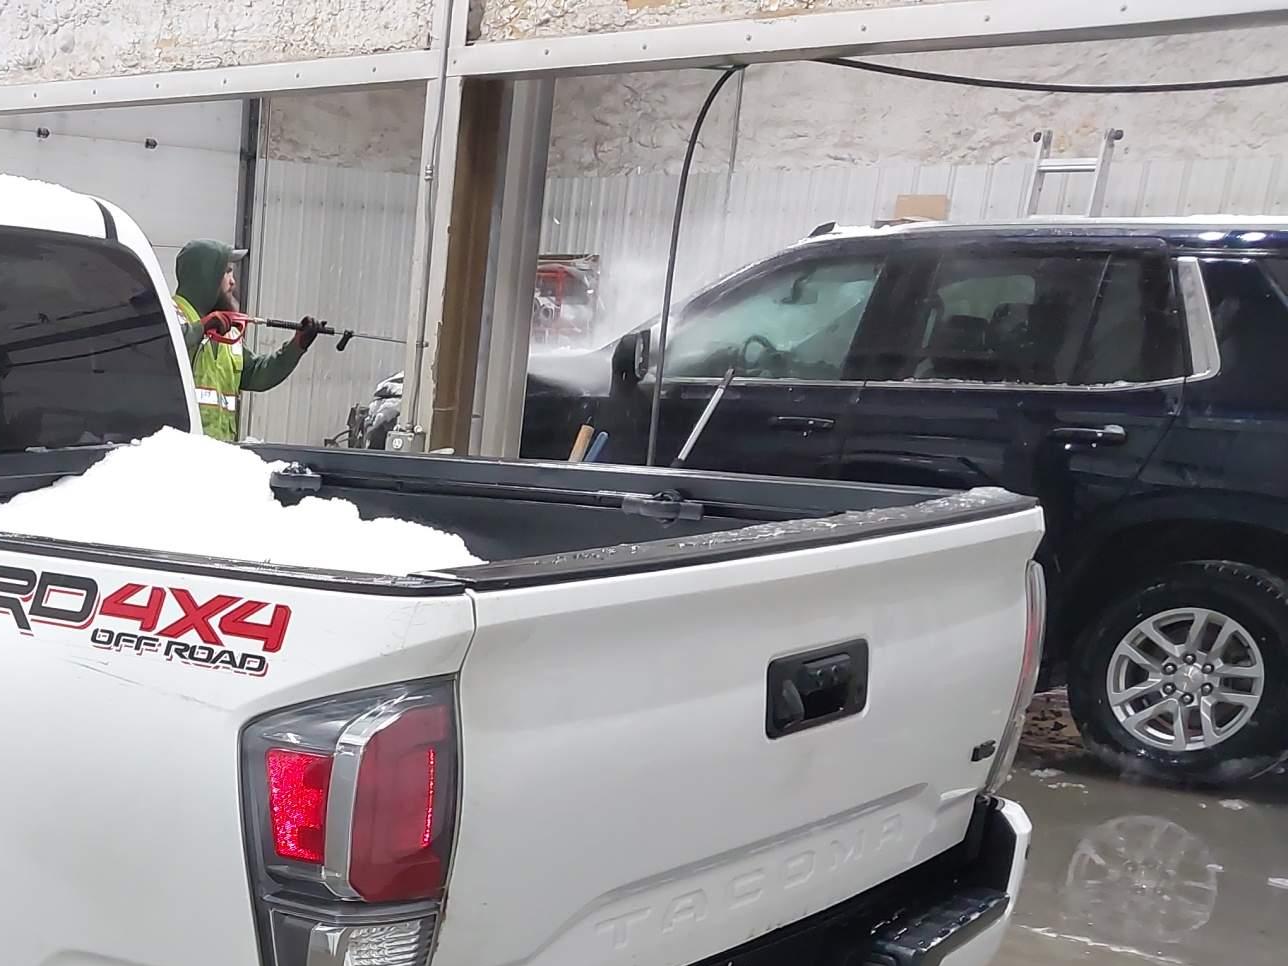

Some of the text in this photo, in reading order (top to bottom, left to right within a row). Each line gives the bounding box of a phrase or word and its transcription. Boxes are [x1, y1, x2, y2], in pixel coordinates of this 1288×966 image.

[90, 628, 269, 677] OFF ROAD
[99, 583, 292, 653] 4X4
[593, 812, 905, 951] TACOMA
